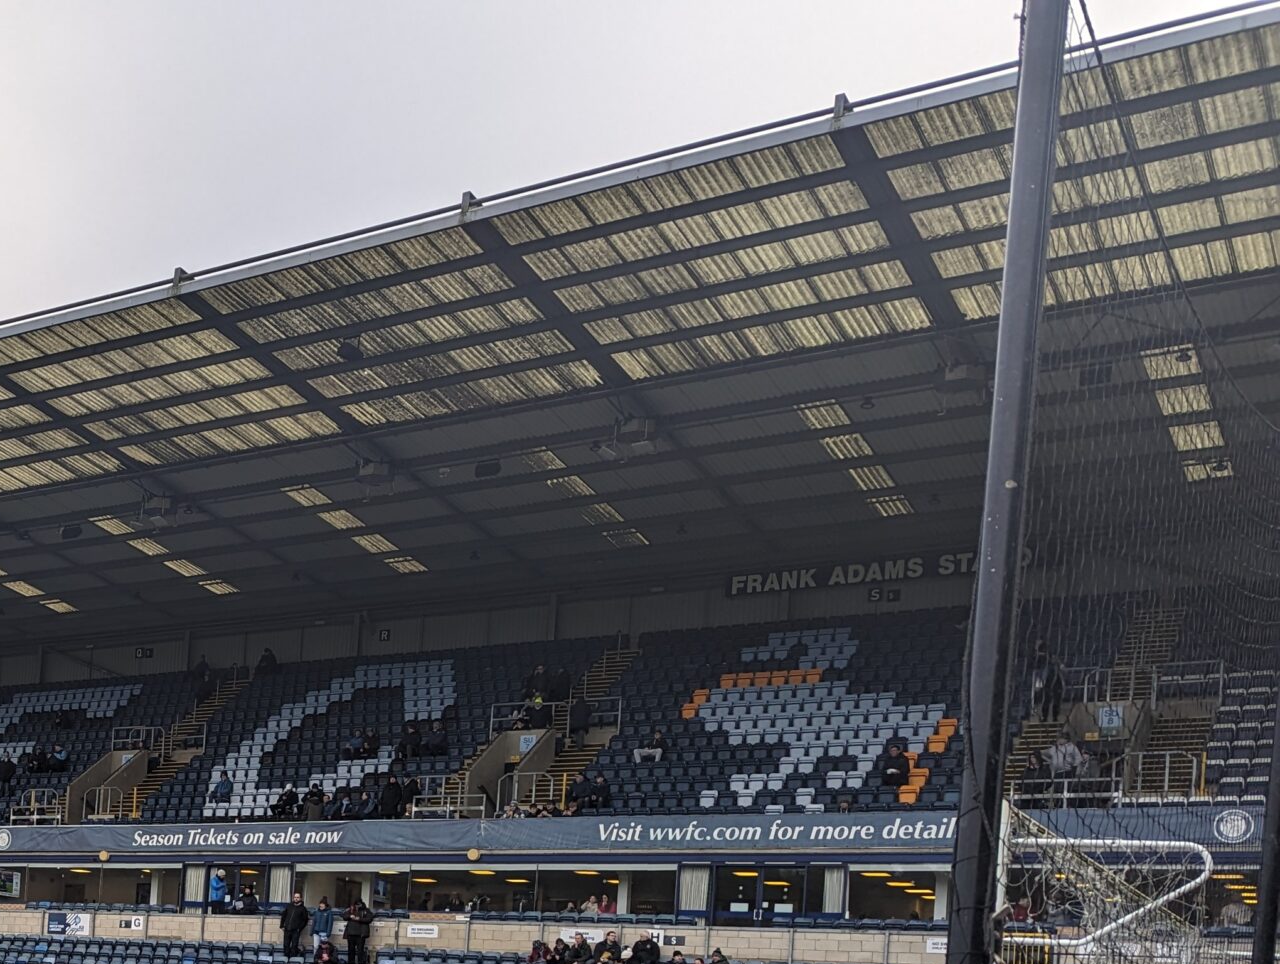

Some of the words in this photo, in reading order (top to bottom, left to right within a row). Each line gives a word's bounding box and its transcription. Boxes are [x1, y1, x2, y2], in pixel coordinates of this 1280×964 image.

[731, 569, 816, 595] FRANK
[828, 557, 924, 586] ADAMS
[938, 546, 1032, 576] STD
[132, 830, 183, 846] Season
[187, 828, 239, 846] Tickets
[243, 831, 264, 845] on
[267, 827, 300, 845] sale
[304, 830, 343, 844] now
[598, 820, 643, 841] Visit
[649, 820, 762, 841] wwfc.com
[768, 819, 803, 842] for
[810, 824, 874, 840] more
[881, 818, 957, 840] detail
[133, 918, 141, 928] G
[651, 932, 660, 943] H
